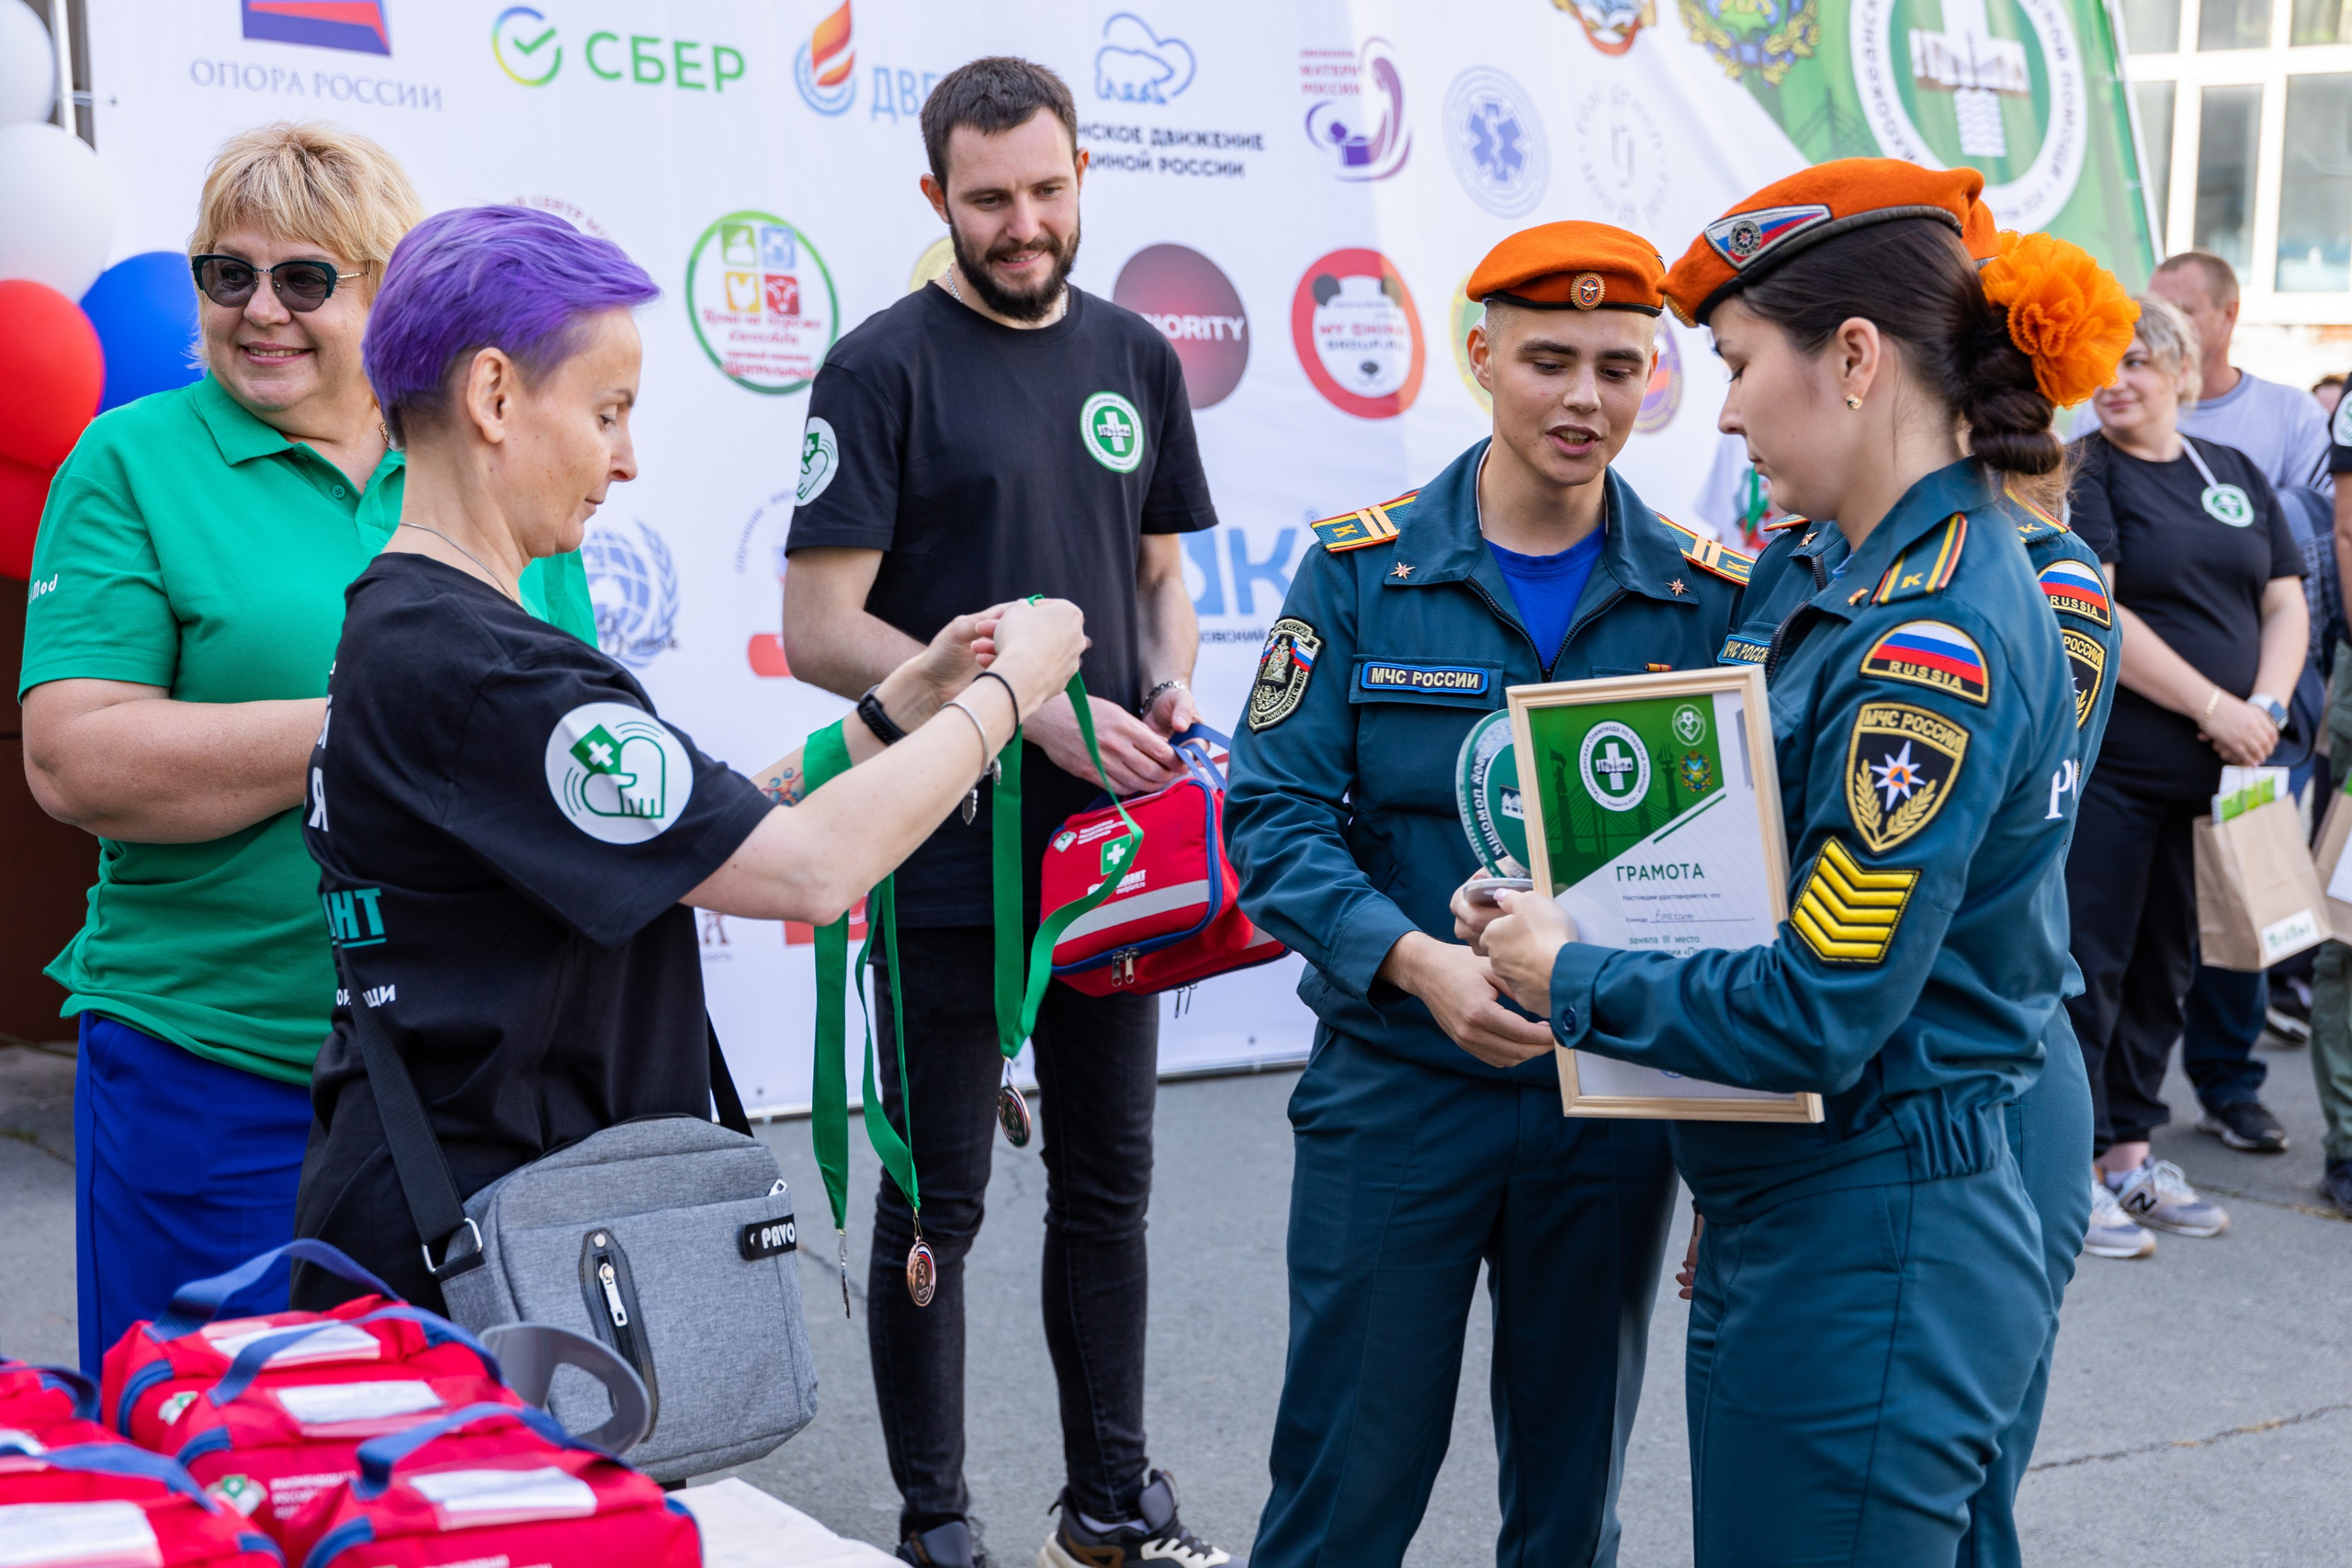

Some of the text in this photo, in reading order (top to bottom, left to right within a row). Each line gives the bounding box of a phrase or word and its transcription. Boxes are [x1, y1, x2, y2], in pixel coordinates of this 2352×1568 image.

[586, 30, 745, 93] СБЕР
[189, 58, 443, 112] ОПОРА РОССИИ
[1077, 123, 1265, 152] НСКОЕ ДВИЖЕНИЕ
[1159, 155, 1245, 178] РОССИИ
[1140, 312, 1245, 341] IORITY
[2050, 594, 2098, 617] RUSSIA
[2064, 636, 2101, 666] РОССИИ
[1371, 668, 1479, 689] МЧС РОССИИ
[1888, 660, 1963, 691] RUSSIA
[1588, 726, 1620, 743] Олимпиада
[1863, 709, 1963, 751] МЧС РОССИИ
[1616, 863, 1705, 882] ГРАМОТА
[1623, 894, 1657, 902] Настоящим
[1658, 893, 1709, 902] удостоверяется,
[1629, 936, 1658, 945] заняла
[1675, 935, 1701, 943] место
[761, 1223, 796, 1249] PAVO
